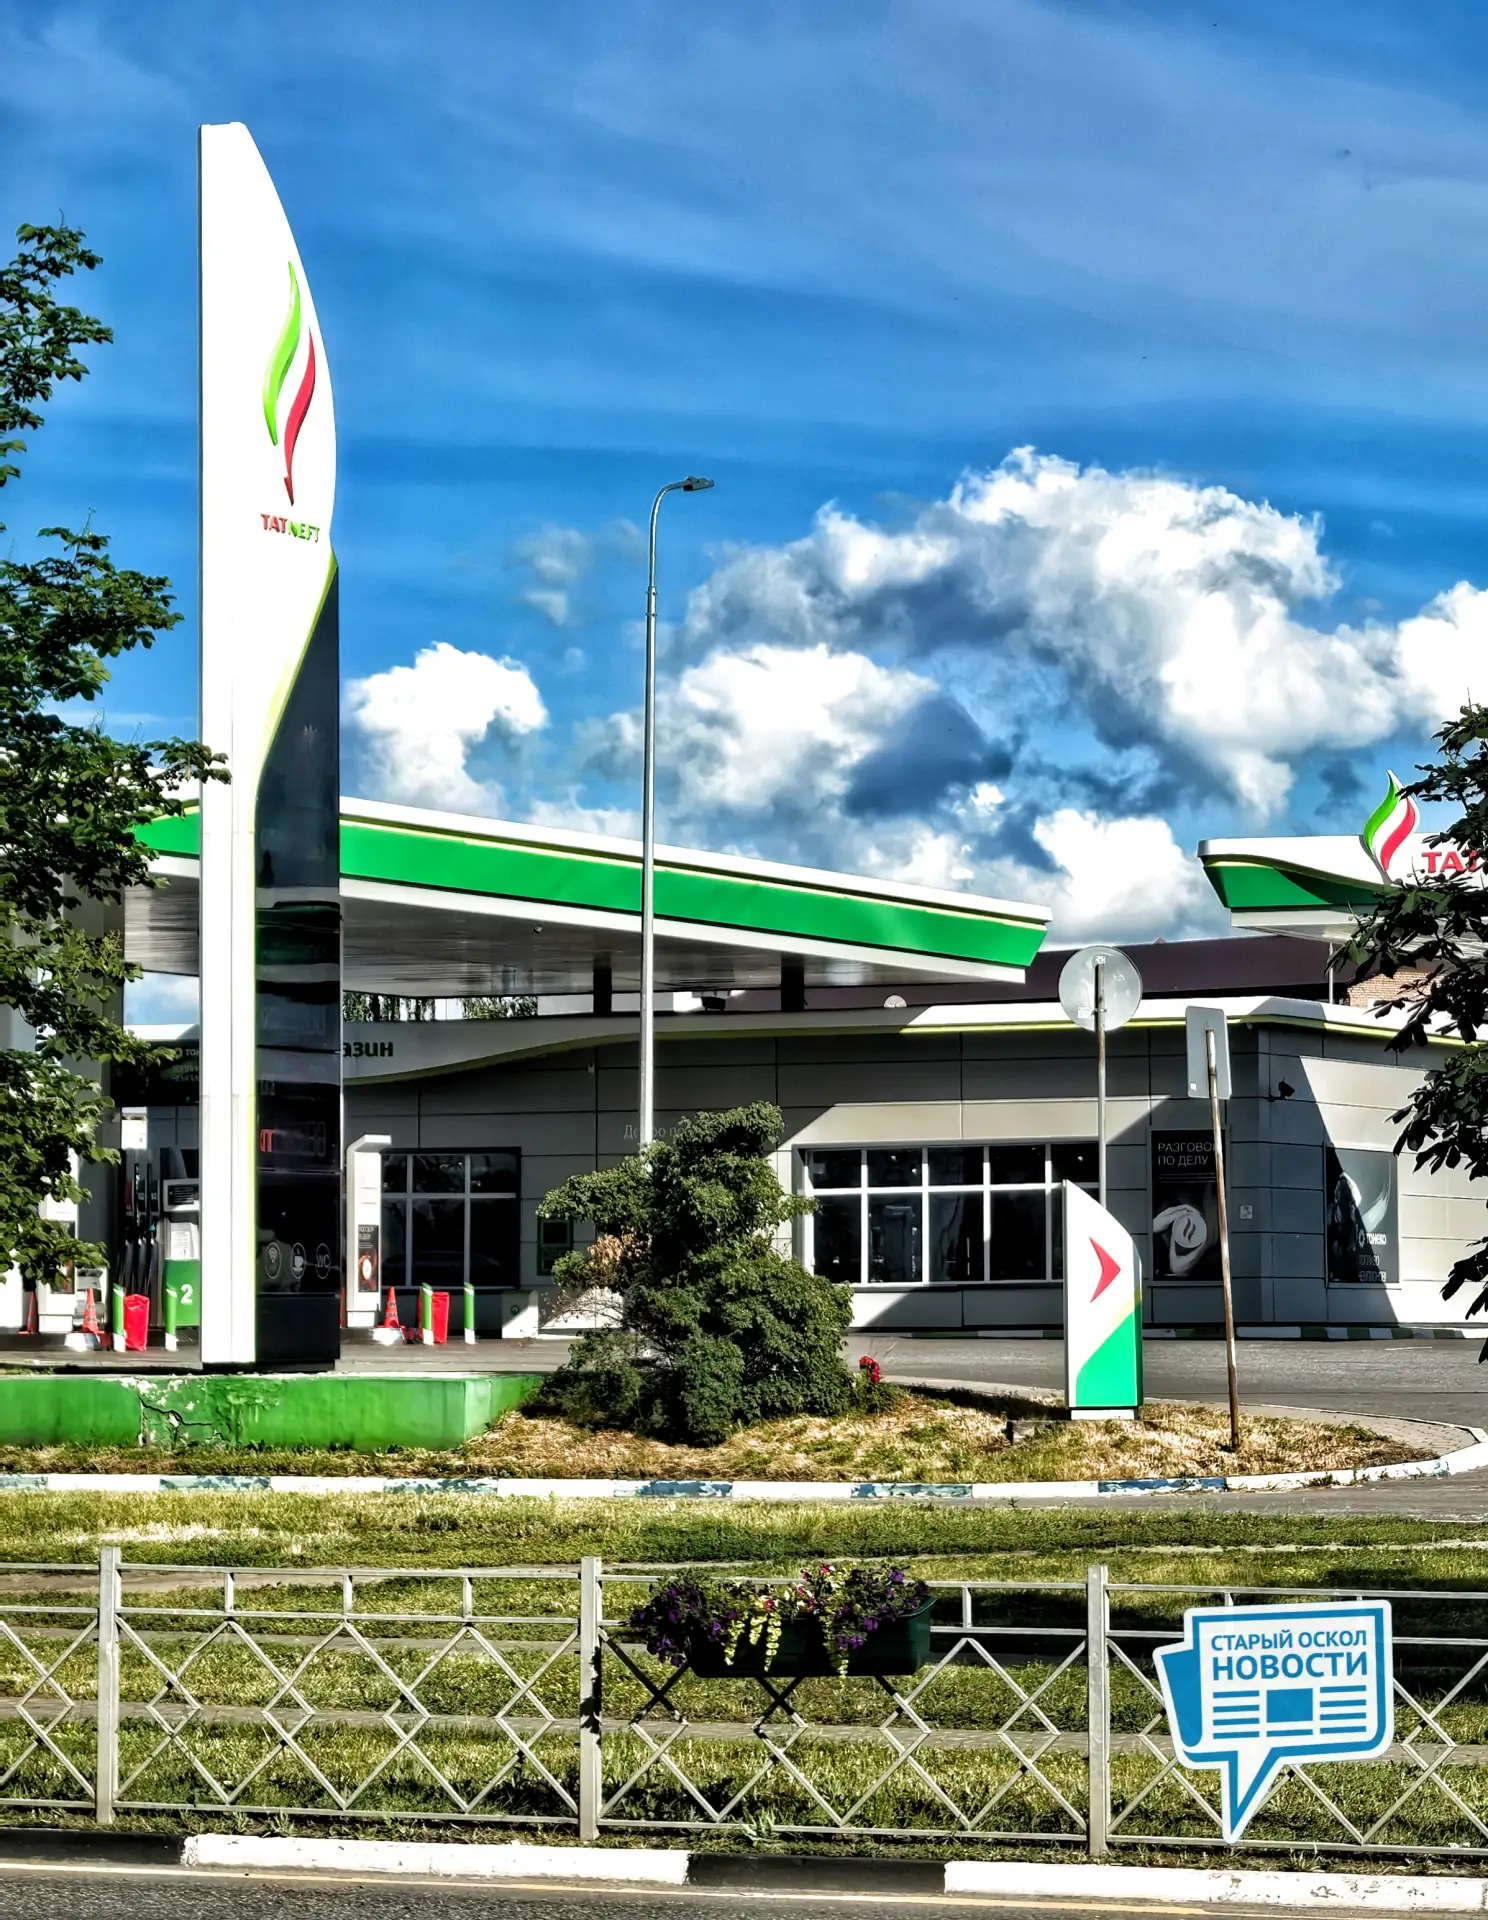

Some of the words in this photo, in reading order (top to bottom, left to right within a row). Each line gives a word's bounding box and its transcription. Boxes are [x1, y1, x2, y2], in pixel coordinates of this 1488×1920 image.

[260, 513, 320, 543] TATNEFT
[1158, 1142, 1216, 1153] РАЗГОВО
[1158, 1155, 1175, 1166] ПО
[1177, 1155, 1209, 1167] ДЕЛУ
[316, 1254, 331, 1268] WC
[180, 1283, 194, 1305] 2
